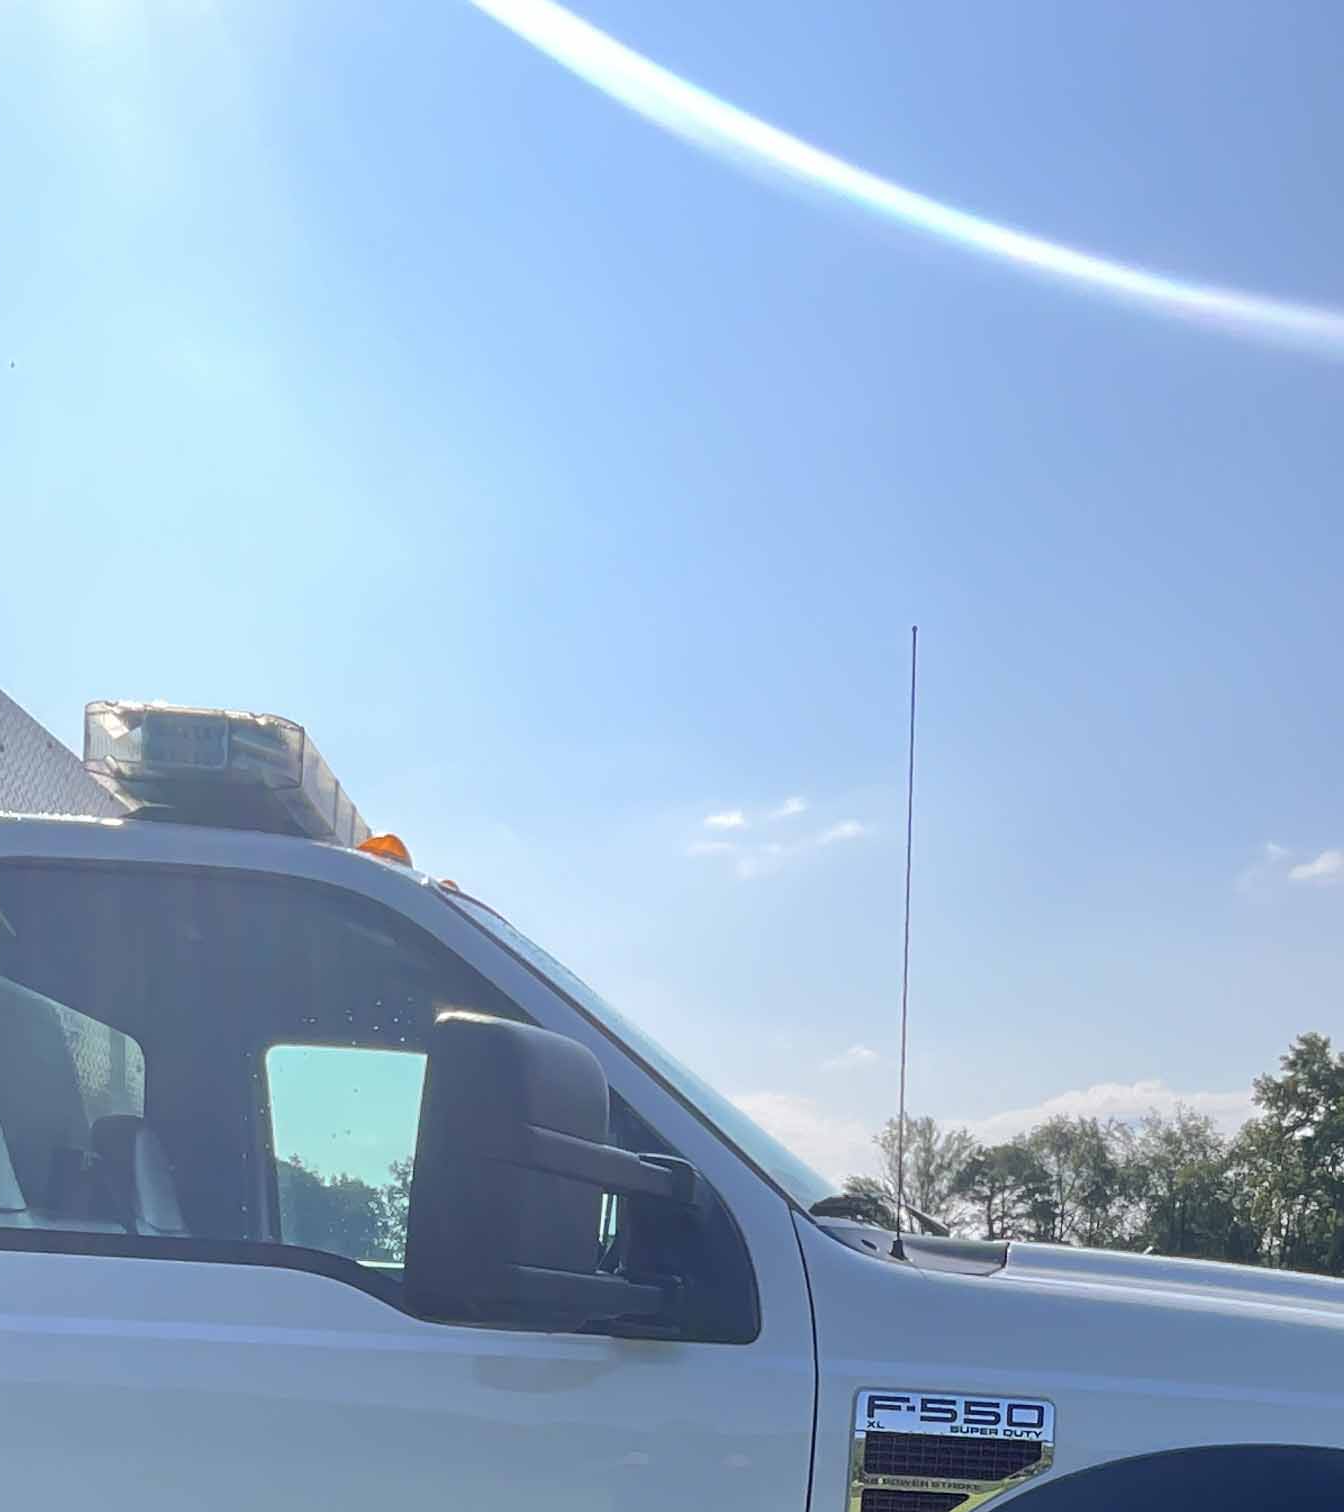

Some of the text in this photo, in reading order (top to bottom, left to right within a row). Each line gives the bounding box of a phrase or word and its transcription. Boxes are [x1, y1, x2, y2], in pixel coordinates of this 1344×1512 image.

[867, 1395, 1044, 1429] F-550
[866, 1420, 885, 1429] XL
[950, 1426, 1042, 1440] SUPER DUTY
